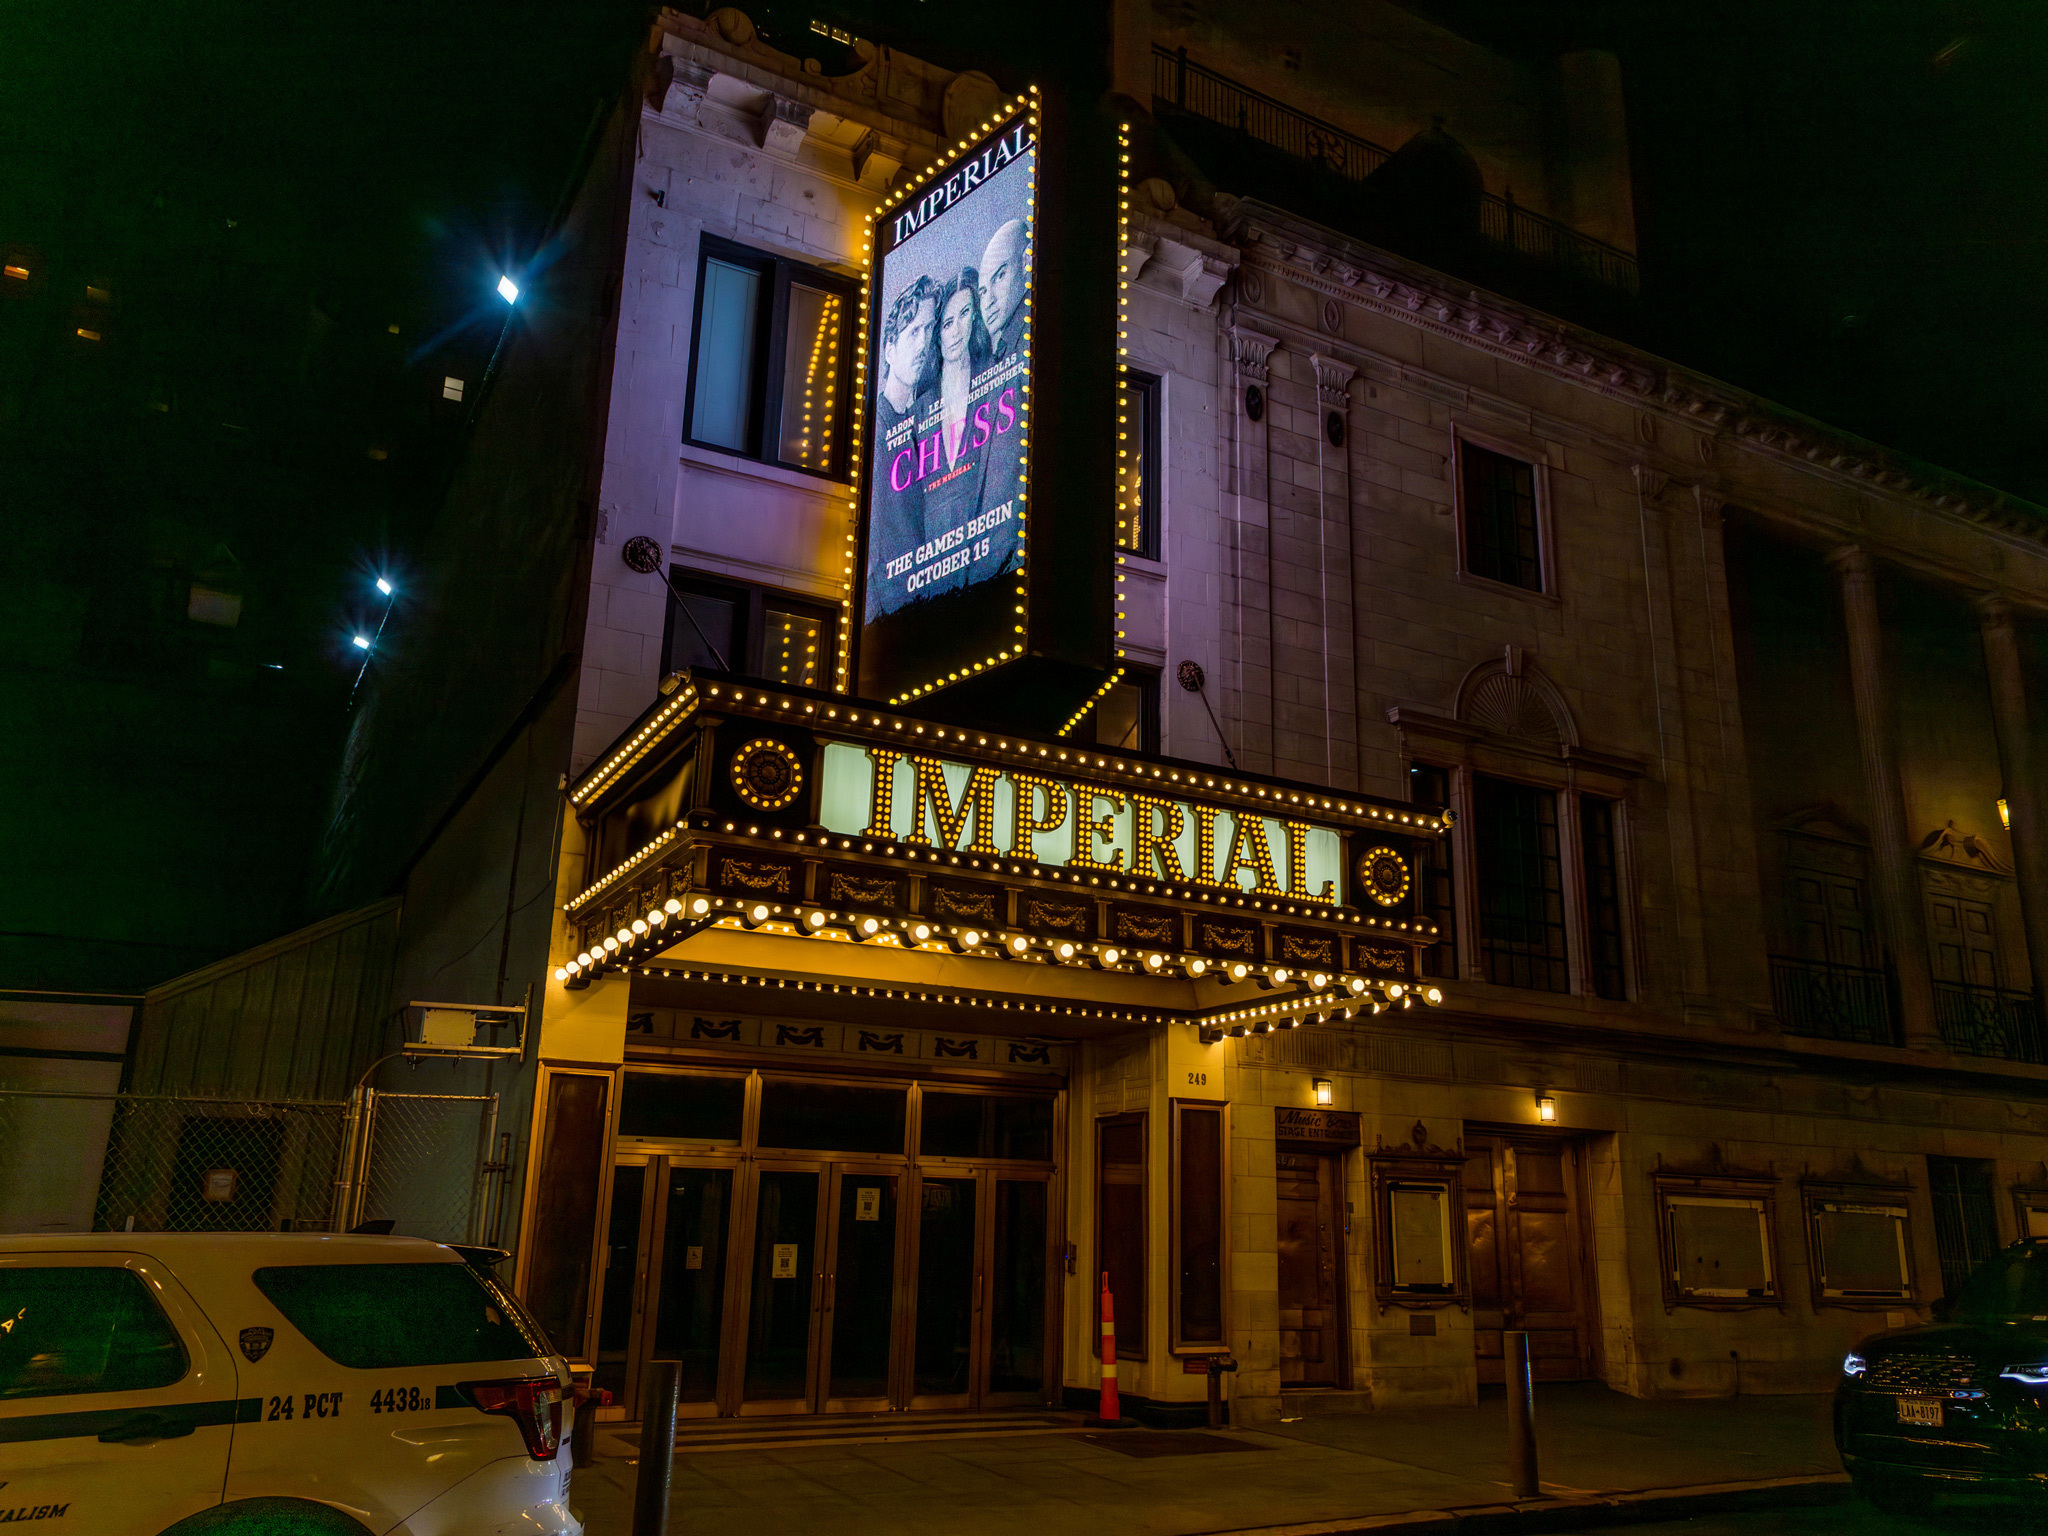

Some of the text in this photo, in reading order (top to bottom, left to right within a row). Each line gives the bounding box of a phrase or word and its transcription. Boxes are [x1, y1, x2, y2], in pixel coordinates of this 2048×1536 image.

[893, 123, 1033, 247] IMPERIAL
[967, 361, 1025, 404] HRISTOPHER
[971, 353, 1017, 389] NICHOLAS
[929, 397, 945, 415] LEA
[885, 415, 915, 441] AARON
[918, 409, 947, 434] MICHE
[887, 429, 912, 452] TVEIT
[890, 388, 1015, 492] CHESS
[928, 479, 941, 491] THE
[885, 500, 1013, 580] THE GAMES BEGIN
[907, 536, 990, 593] OCTOBER 15
[860, 747, 1337, 905] IMPERIAL
[1188, 1072, 1207, 1085] 249
[1278, 1110, 1321, 1127] Music
[1278, 1126, 1354, 1140] STAGE ENTR
[268, 1395, 294, 1422] 24
[303, 1392, 343, 1419] PCT
